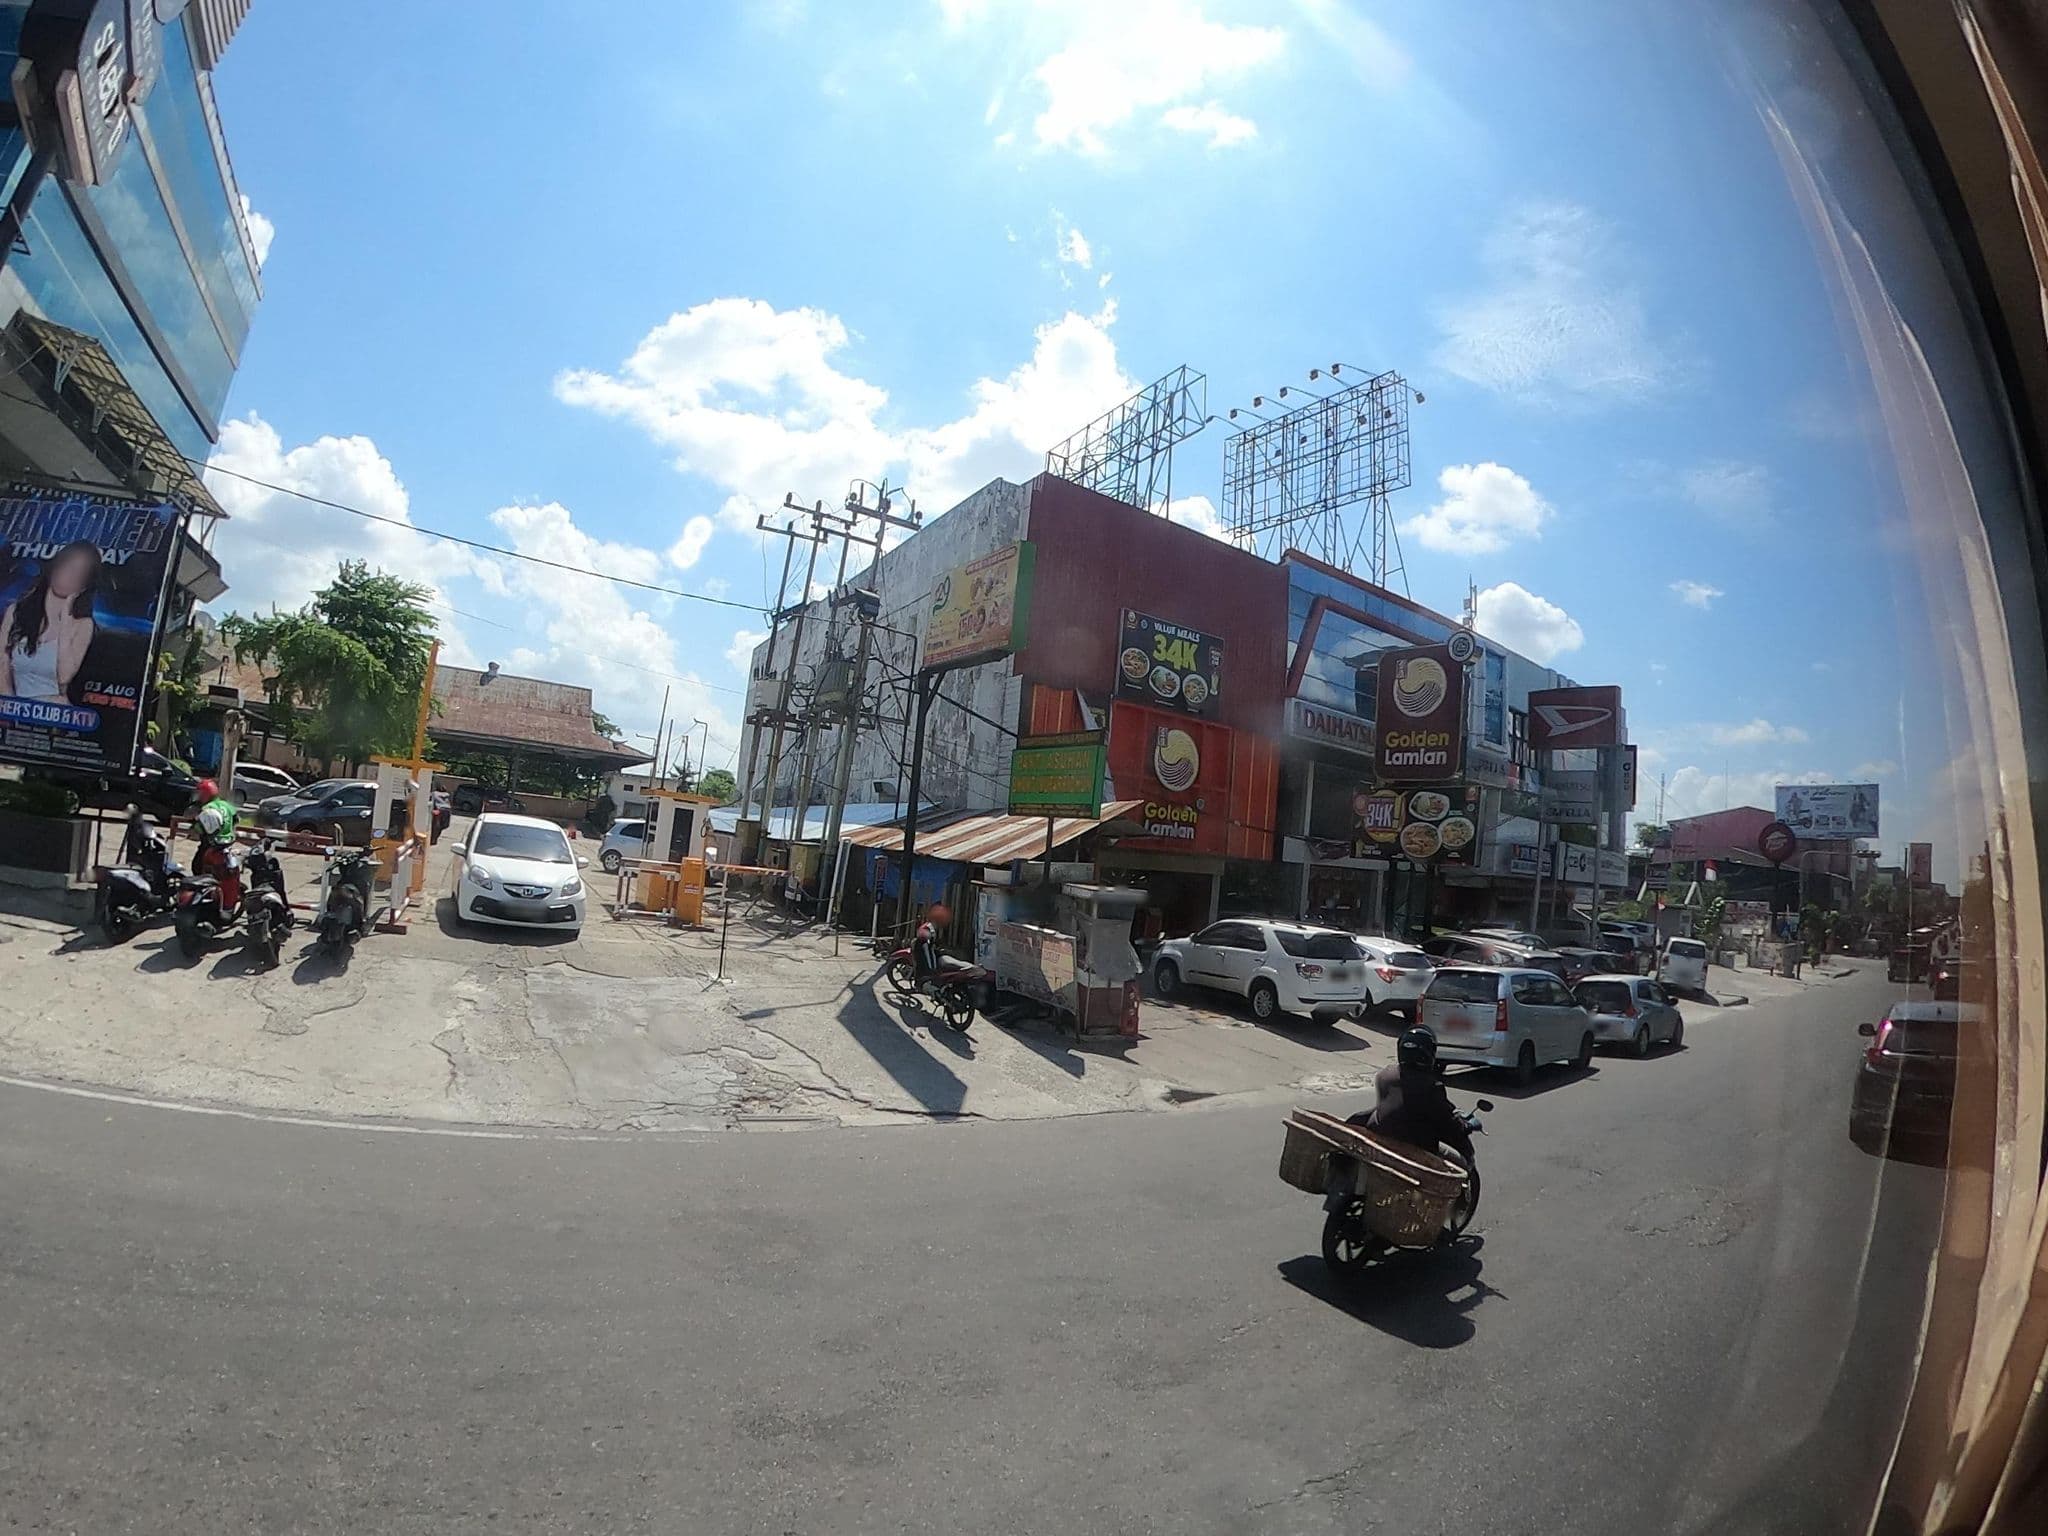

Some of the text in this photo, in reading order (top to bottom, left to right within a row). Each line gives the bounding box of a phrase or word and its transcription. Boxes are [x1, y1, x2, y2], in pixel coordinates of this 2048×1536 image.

[1153, 633, 1198, 671] 34K
[103, 683, 136, 697] AUG
[32, 703, 61, 724] CLUB
[71, 710, 97, 728] KTV
[1385, 730, 1450, 749] Golden
[1144, 801, 1198, 824] Golden
[1366, 803, 1394, 828] 34K
